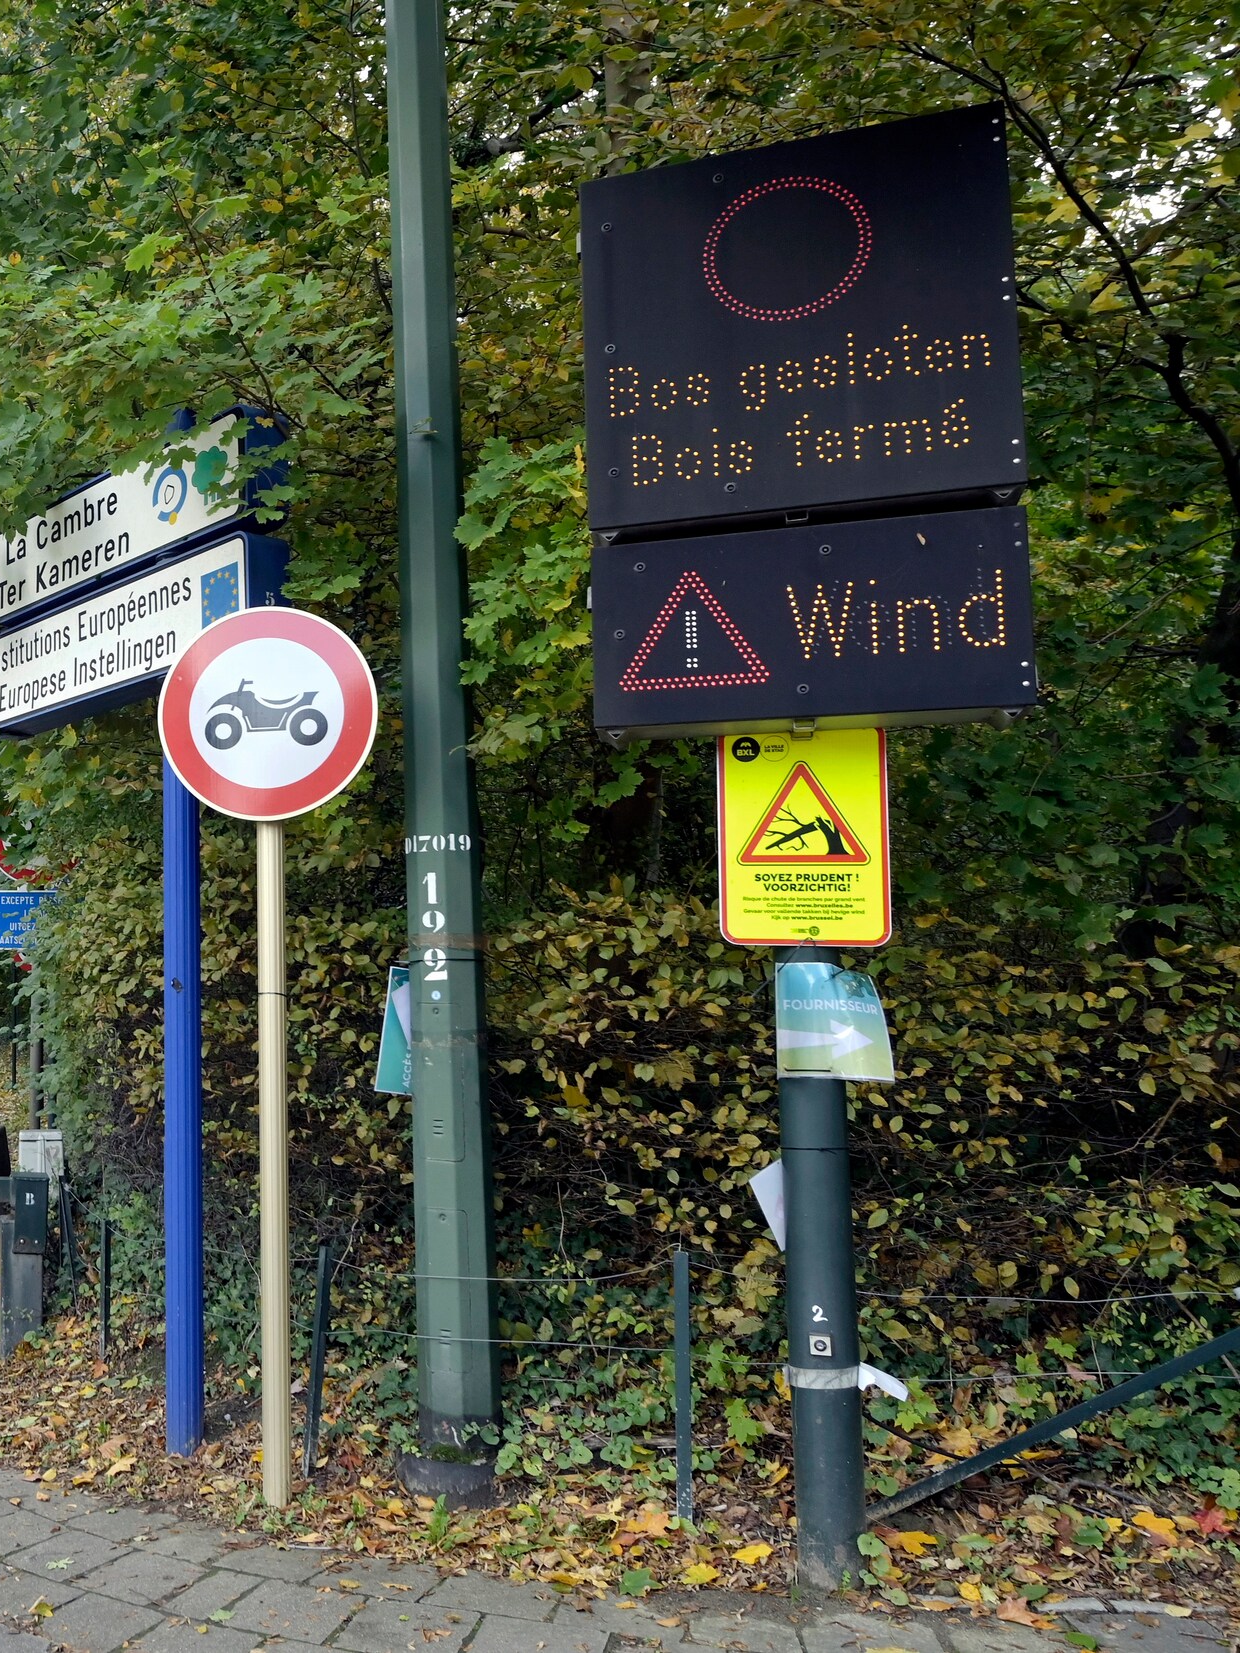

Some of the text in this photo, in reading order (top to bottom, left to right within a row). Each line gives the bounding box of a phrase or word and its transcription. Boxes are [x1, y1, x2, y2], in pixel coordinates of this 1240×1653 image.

[609, 324, 992, 417] Bos gesloten
[632, 398, 969, 487] Bois fermé
[6, 491, 119, 566] La Cambre
[35, 531, 130, 594] Kameren
[77, 576, 192, 642] Européennes
[786, 568, 1006, 659] Wind
[73, 630, 177, 687] Instellingen
[736, 748, 755, 756] BXL
[754, 873, 793, 882] SOYEZ
[795, 873, 853, 882] PRUDENT
[763, 883, 851, 892] VOORZICHTIG!
[0, 896, 35, 905] EXCEPTE
[9, 922, 37, 931] UITGEZ
[782, 999, 879, 1016] FOURNISSEUR
[25, 1192, 36, 1206] B
[811, 1304, 829, 1322] 2
